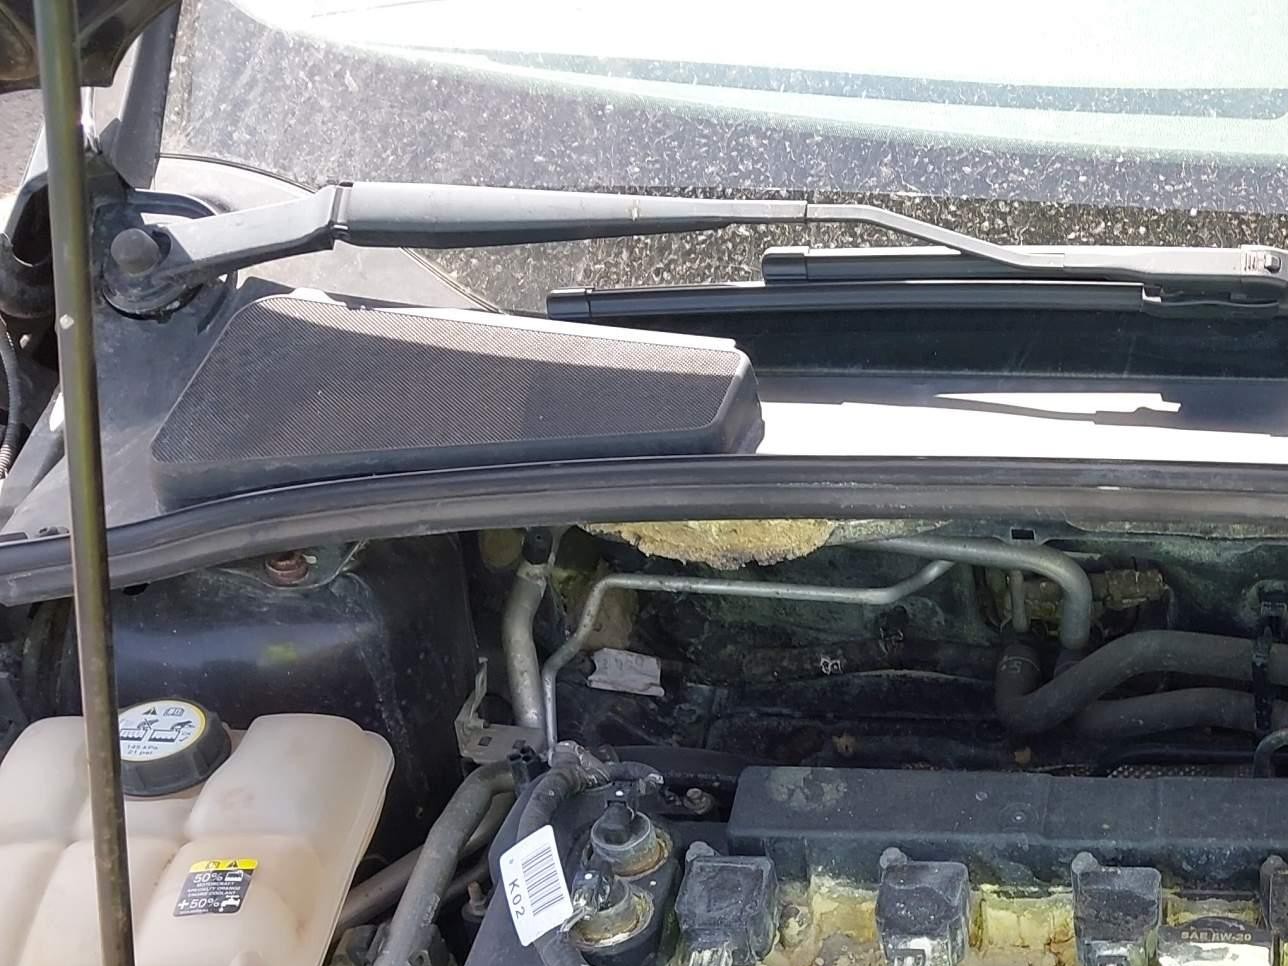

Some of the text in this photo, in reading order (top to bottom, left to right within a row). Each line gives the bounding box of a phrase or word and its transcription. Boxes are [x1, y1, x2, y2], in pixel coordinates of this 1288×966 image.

[193, 872, 224, 884] 50%
[507, 877, 527, 920] K02
[1180, 931, 1208, 943] SAE
